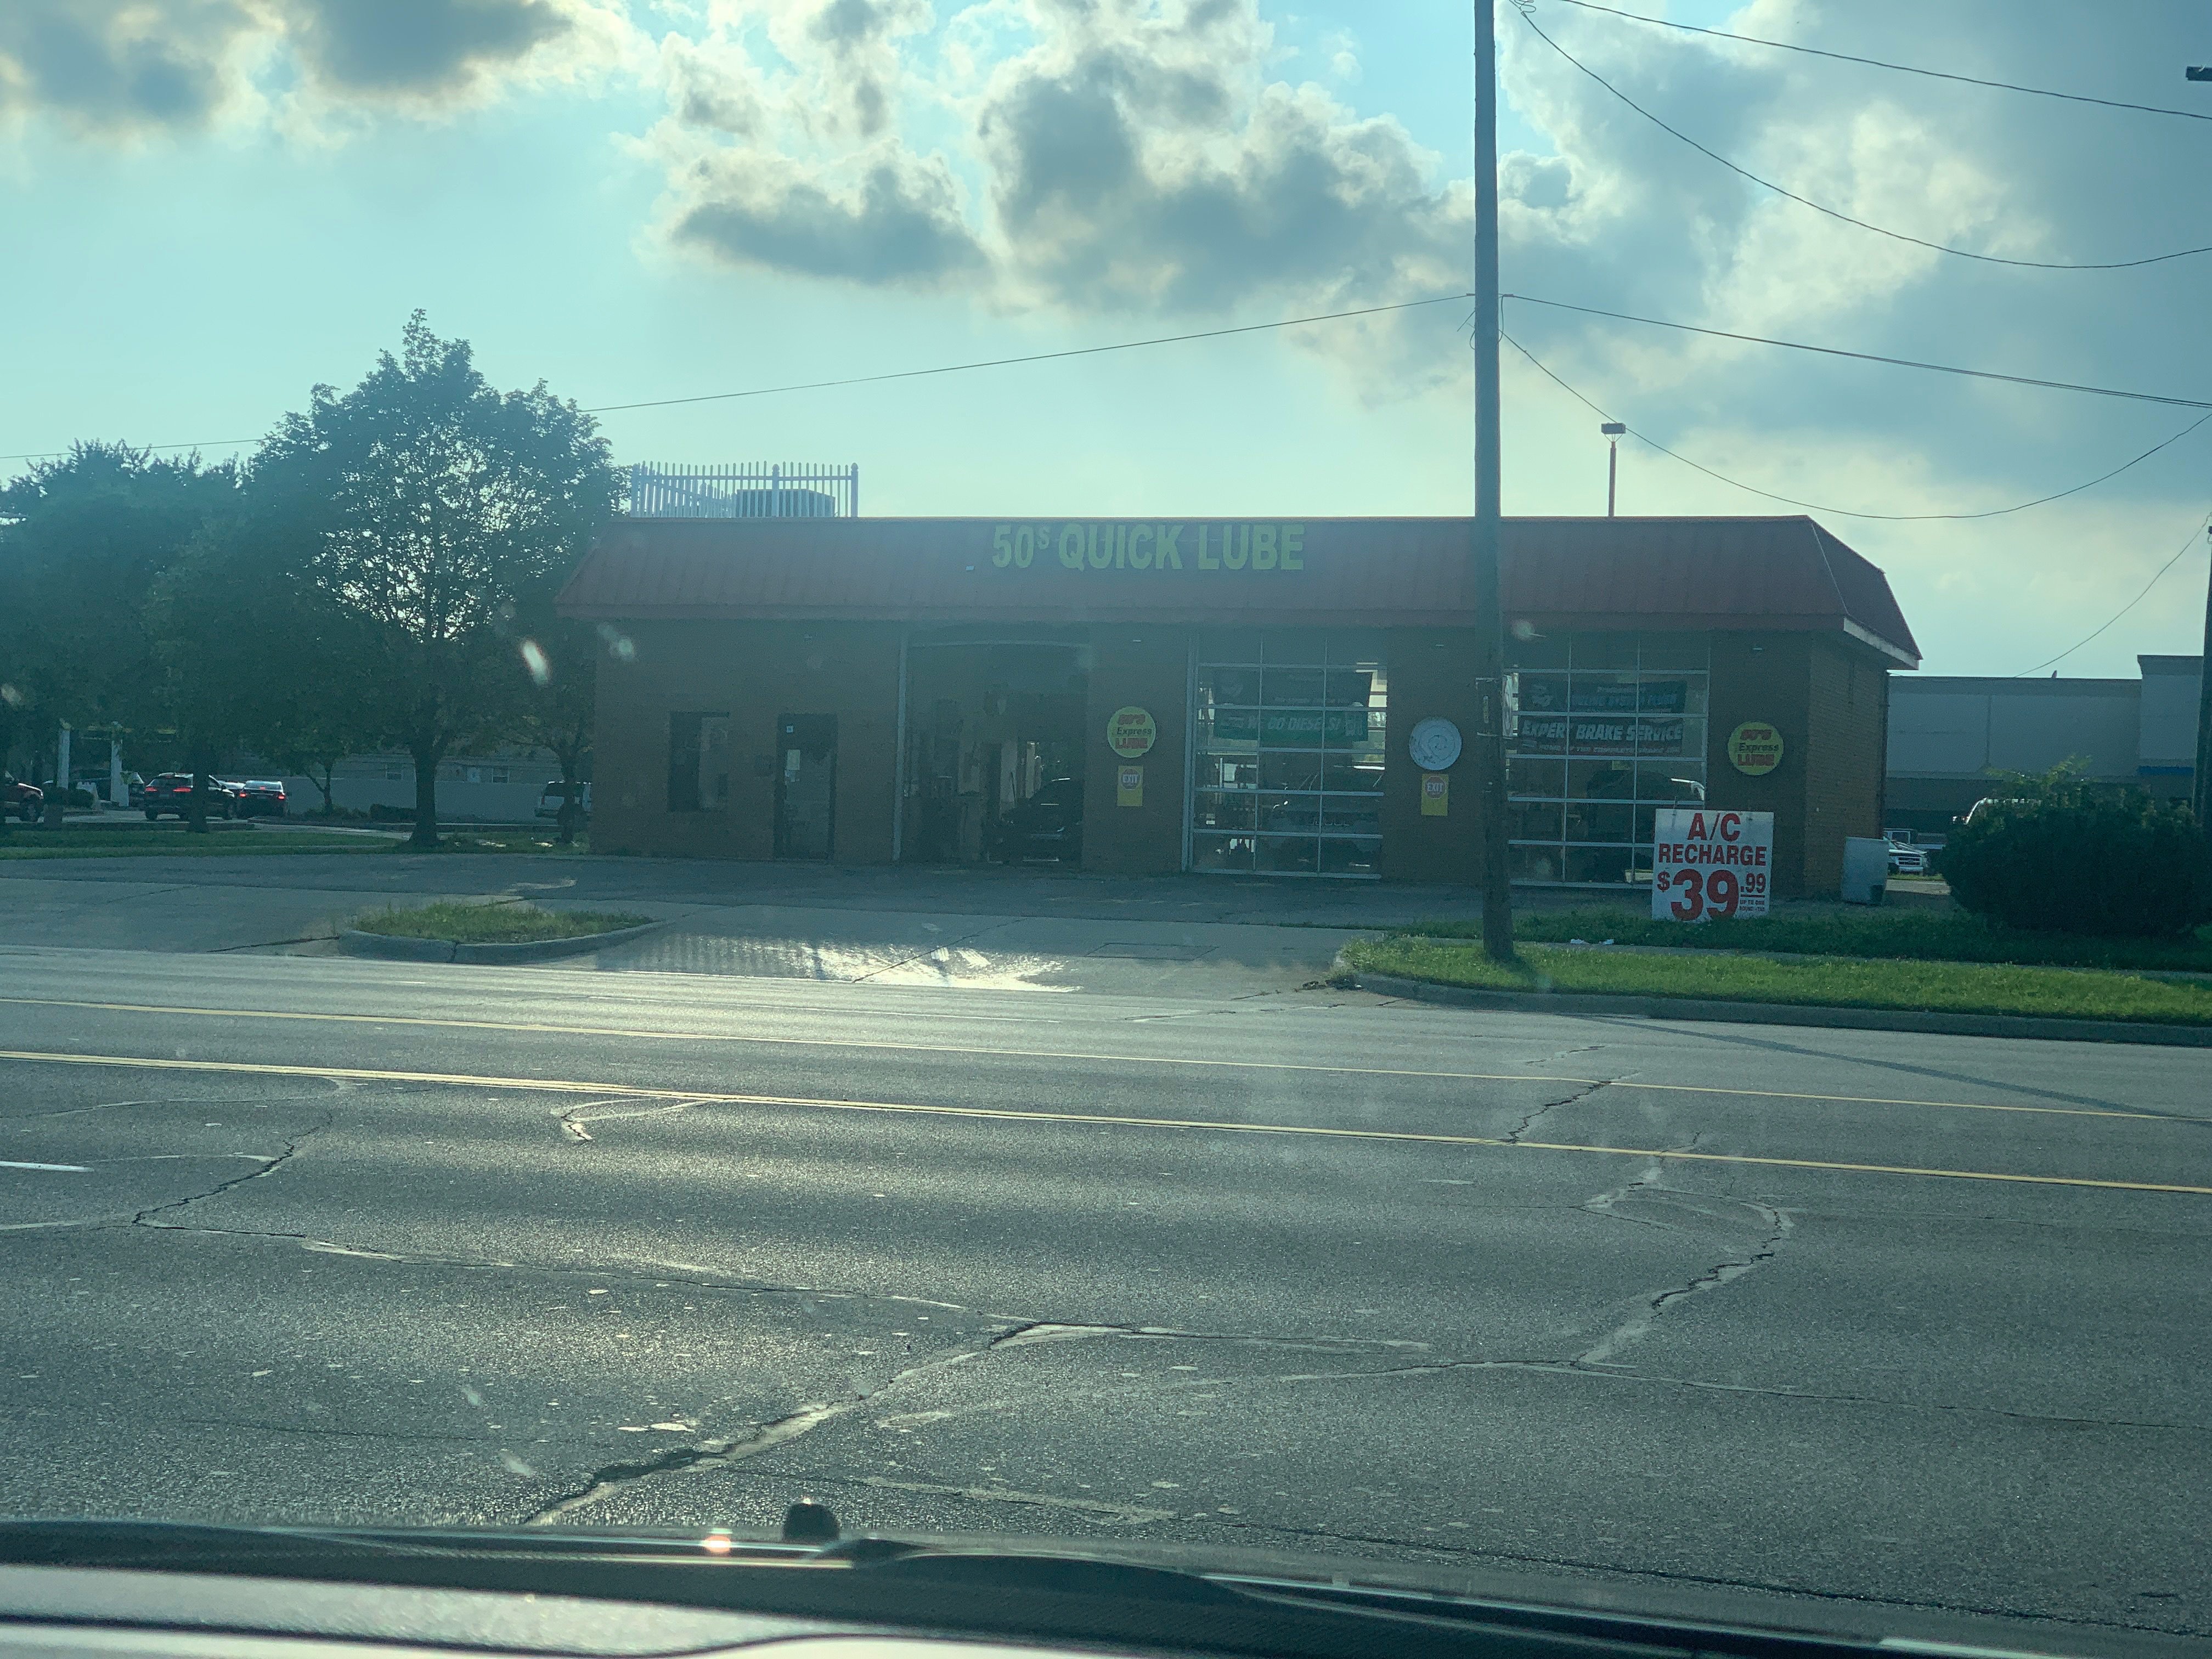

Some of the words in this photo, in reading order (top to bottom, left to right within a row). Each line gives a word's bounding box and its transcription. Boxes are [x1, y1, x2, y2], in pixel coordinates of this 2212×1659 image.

[1059, 523, 1184, 571] QUICK
[1198, 523, 1305, 570] LUBE
[1287, 717, 1341, 730] DIESES!
[1116, 727, 1152, 737] Express
[1576, 724, 1624, 741] BRAKE
[1626, 724, 1683, 741] SERVICE
[1738, 742, 1779, 753] Express
[1427, 782, 1443, 792] EXIT
[1687, 812, 1741, 842] A/C
[1658, 843, 1767, 866] RECHARGE
